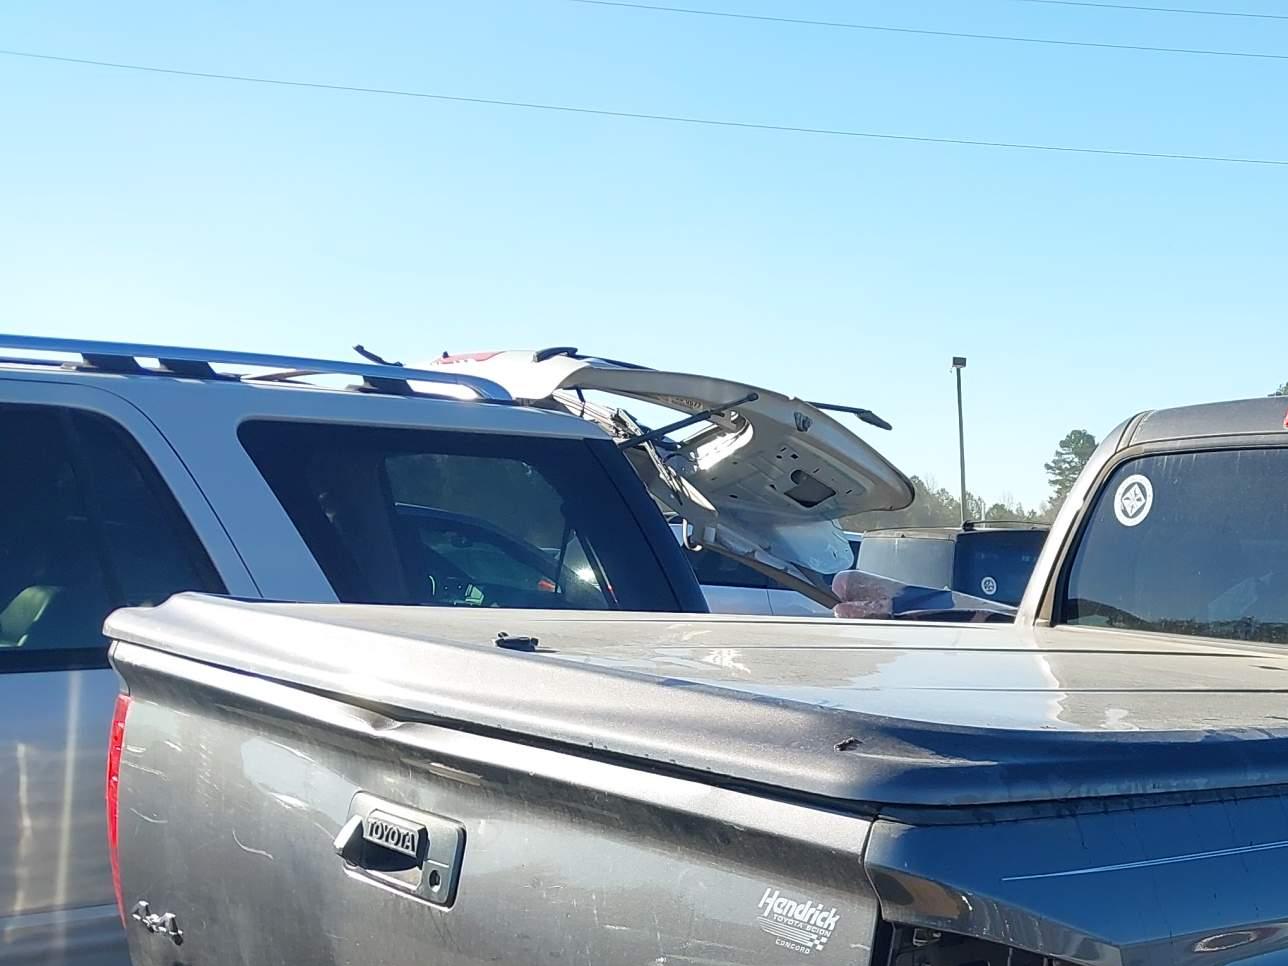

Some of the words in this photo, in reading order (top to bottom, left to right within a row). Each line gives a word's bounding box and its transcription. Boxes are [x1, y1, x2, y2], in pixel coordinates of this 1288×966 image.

[368, 819, 416, 852] TOYOTA
[758, 887, 840, 931] Hendrick
[773, 914, 803, 929] TOYOTA
[806, 924, 832, 938] SCION
[775, 938, 811, 955] CONCORD
